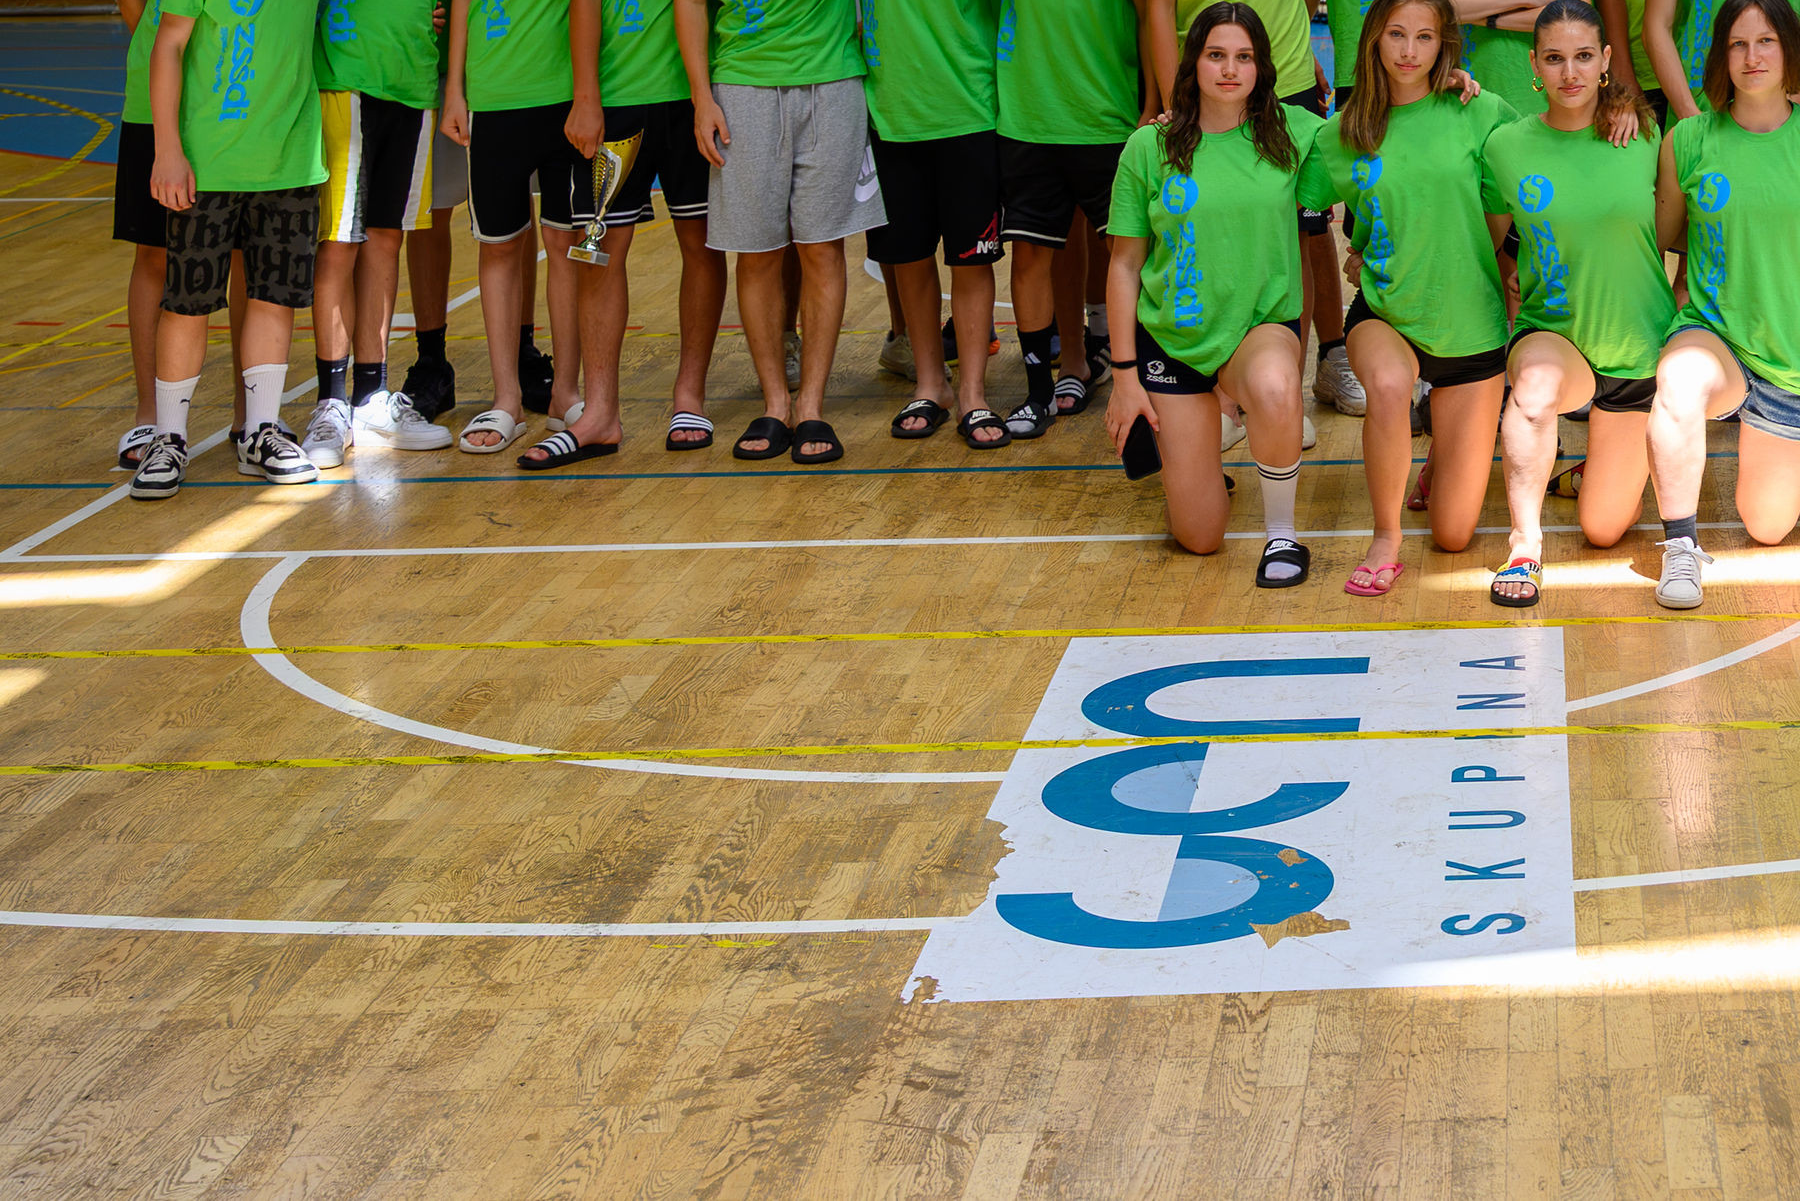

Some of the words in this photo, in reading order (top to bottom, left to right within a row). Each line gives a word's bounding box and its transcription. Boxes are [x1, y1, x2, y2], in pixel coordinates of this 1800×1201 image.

[219, 22, 256, 122] zsšdi
[1174, 220, 1204, 330] zsšdi
[972, 409, 992, 418] NIKE
[1270, 540, 1294, 549] NIKE
